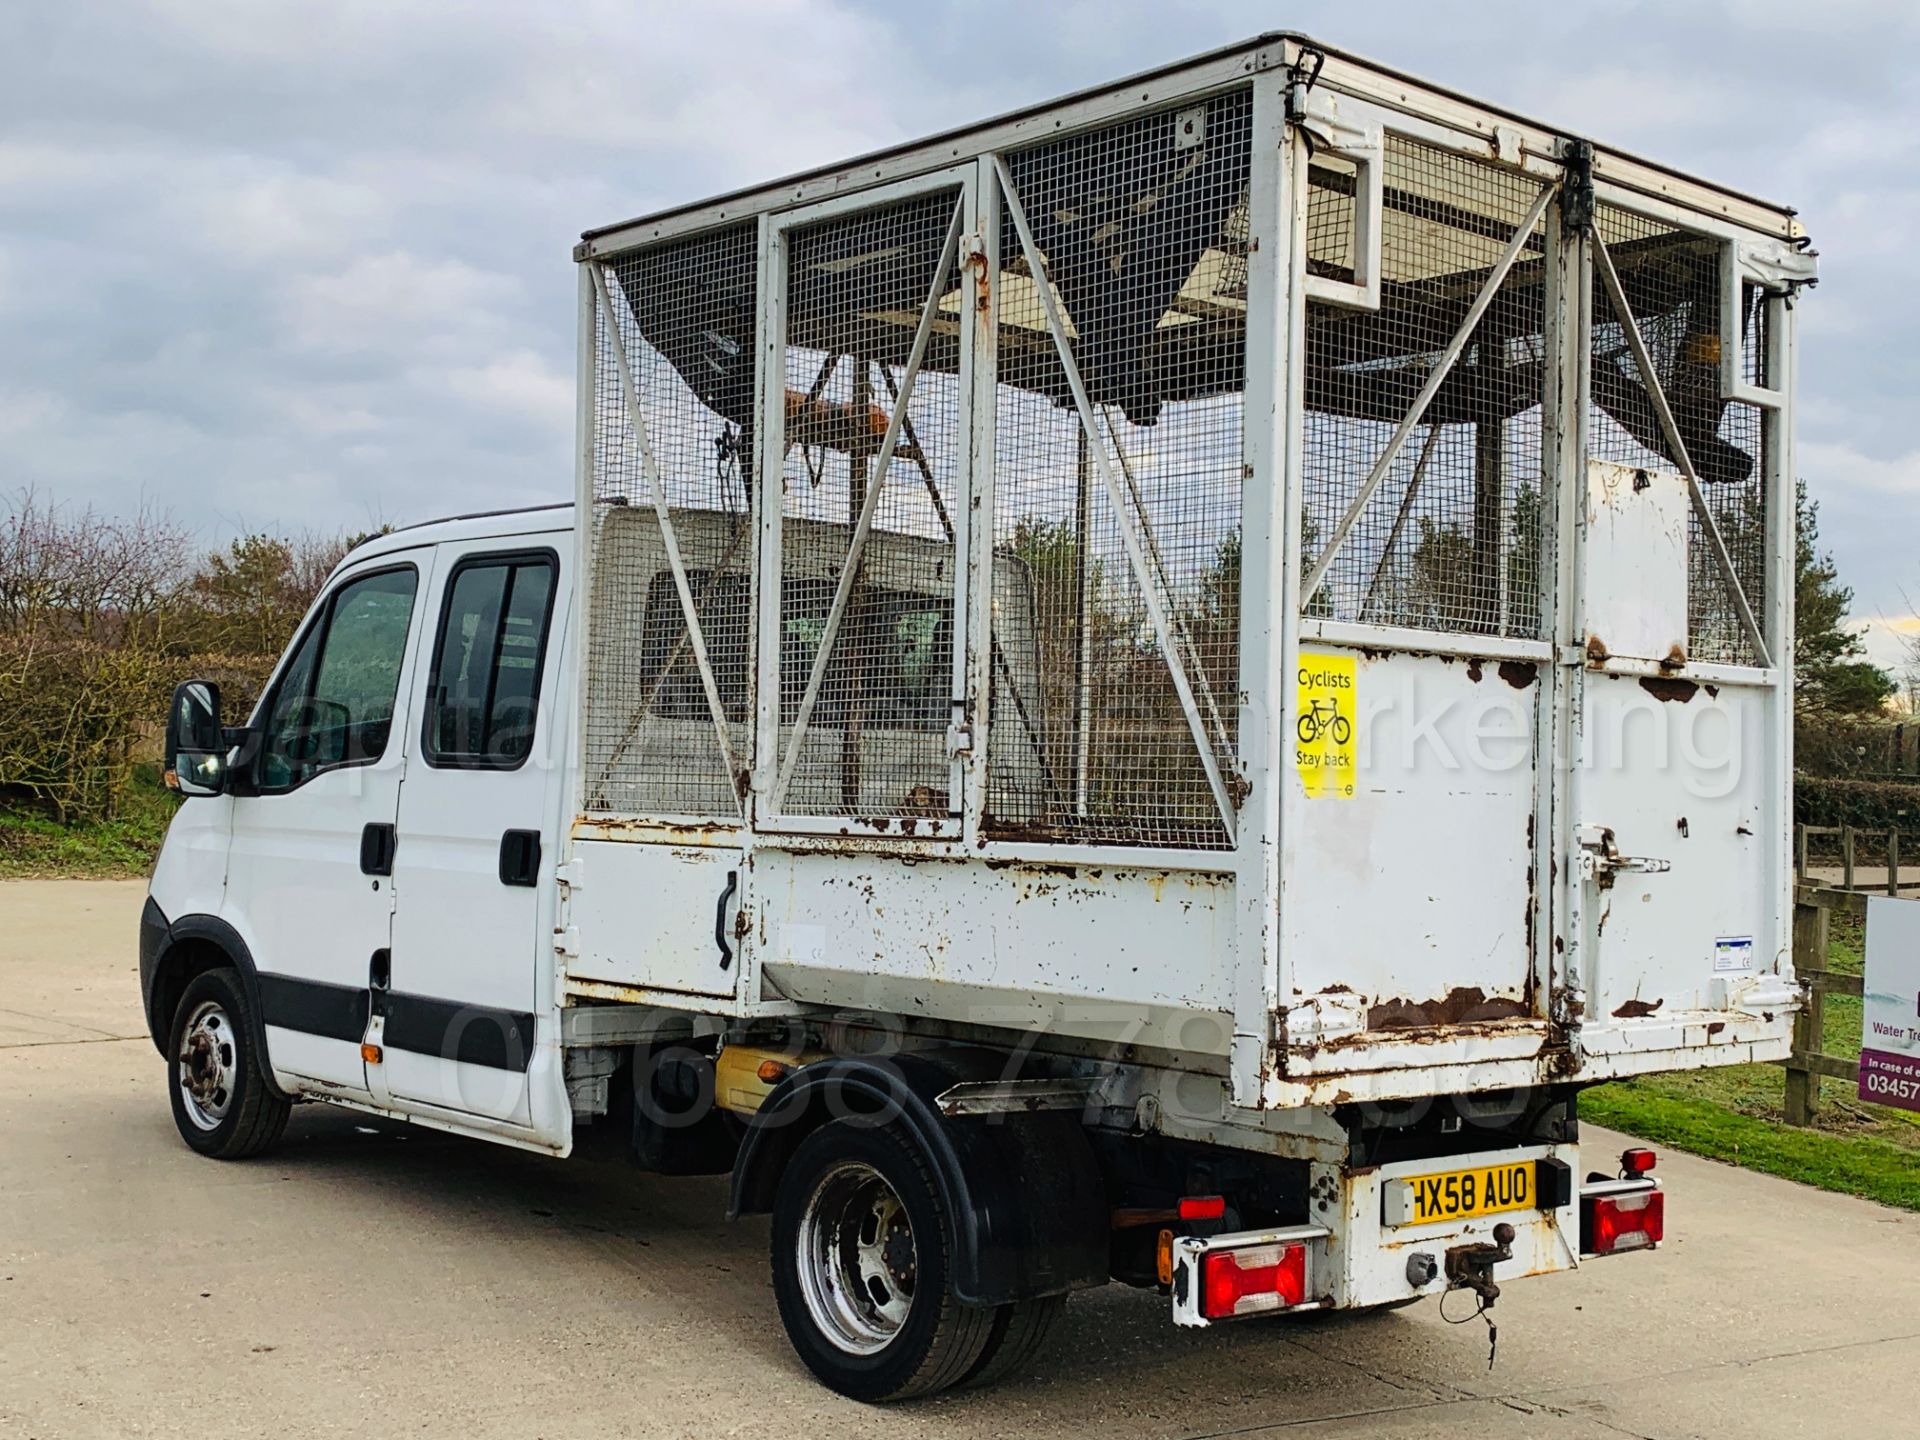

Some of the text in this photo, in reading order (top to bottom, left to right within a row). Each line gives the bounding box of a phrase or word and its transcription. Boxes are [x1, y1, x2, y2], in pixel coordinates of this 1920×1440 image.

[1298, 668, 1351, 690] Cyclists
[1296, 750, 1350, 769] Stay back
[1873, 1022, 1904, 1038] Water
[1868, 1058, 1879, 1068] In
[1880, 1062, 1902, 1073] case
[1903, 1065, 1913, 1076] of
[1867, 1073, 1920, 1100] 03457
[1410, 1174, 1475, 1217] HX58
